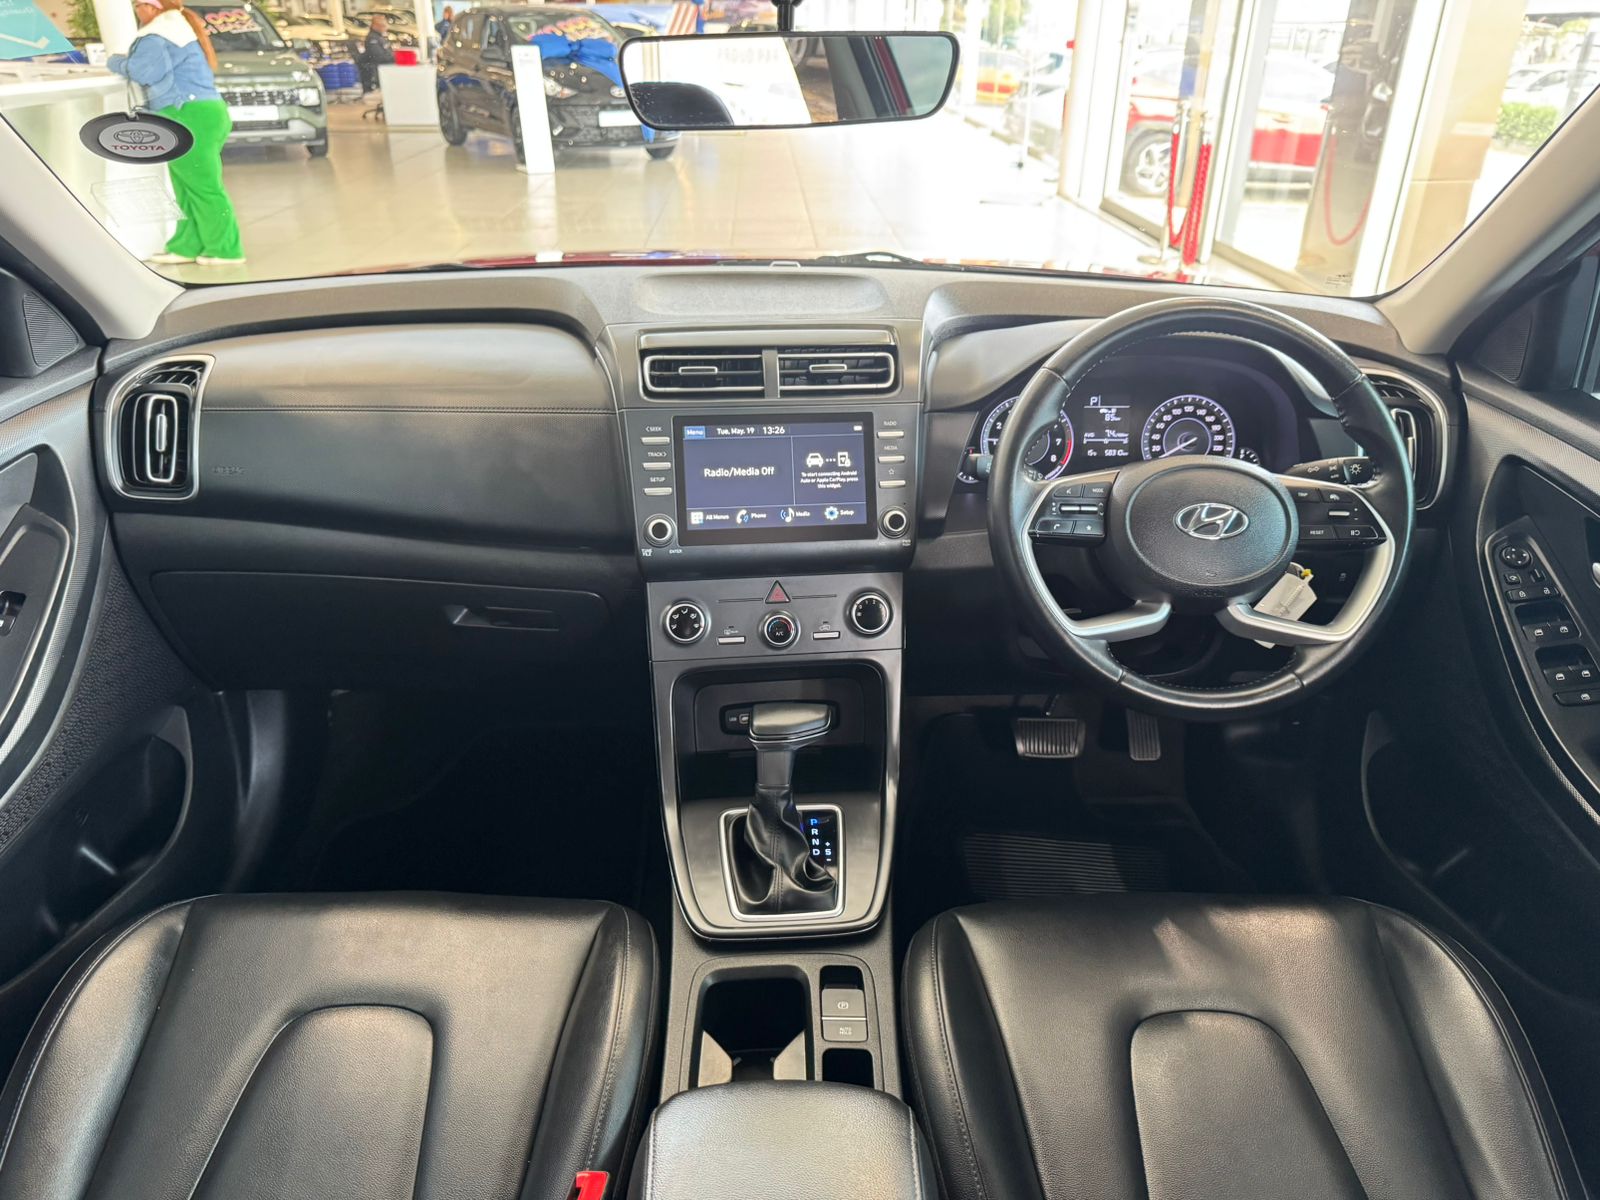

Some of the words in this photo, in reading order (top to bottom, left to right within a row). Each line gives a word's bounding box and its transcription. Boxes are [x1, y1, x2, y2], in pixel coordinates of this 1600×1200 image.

[1090, 396, 1098, 406] P
[763, 426, 785, 434] 13:26
[704, 467, 759, 477] Radio/Media
[761, 467, 774, 475] Off
